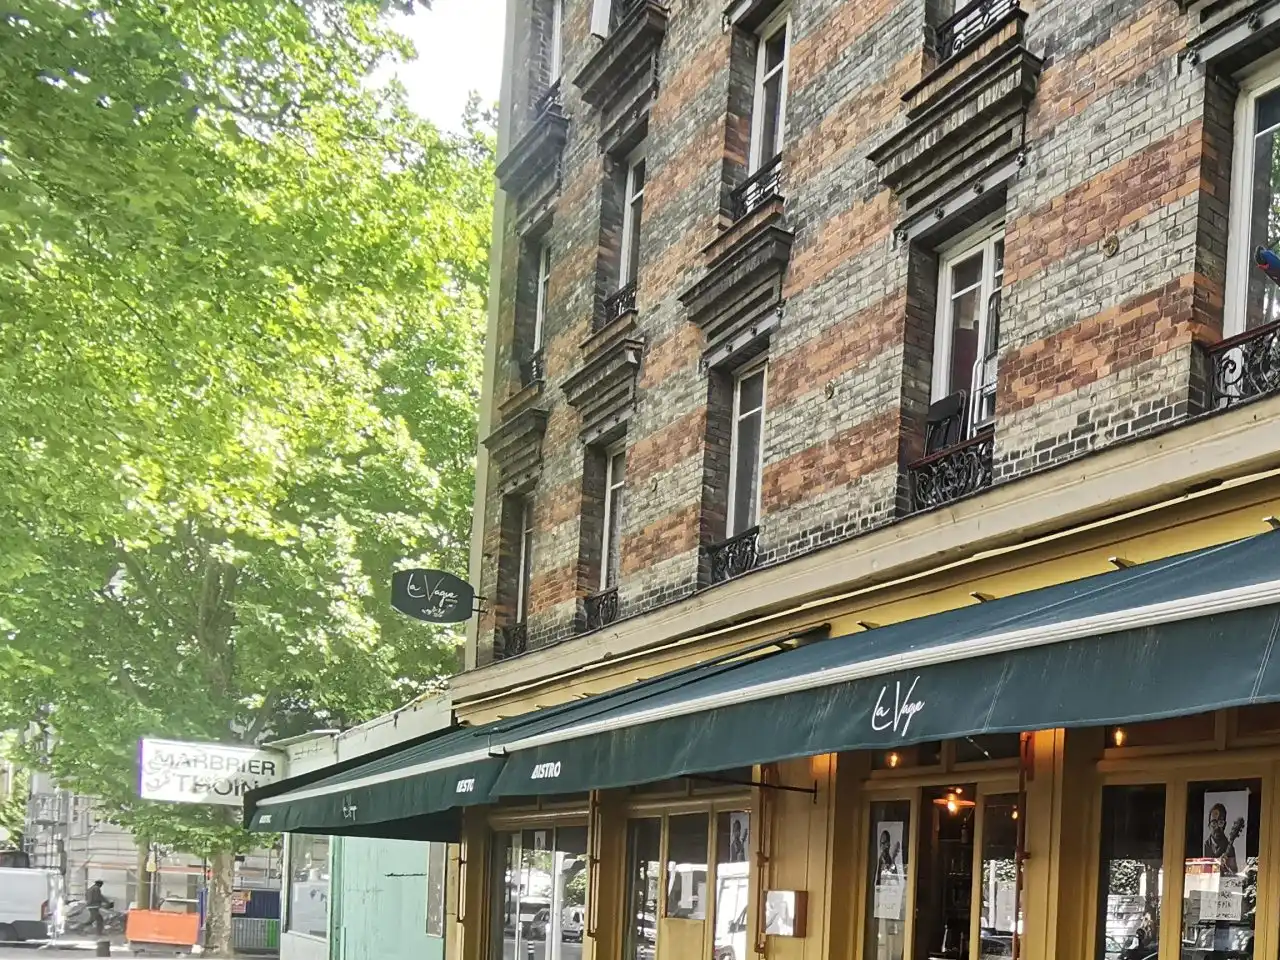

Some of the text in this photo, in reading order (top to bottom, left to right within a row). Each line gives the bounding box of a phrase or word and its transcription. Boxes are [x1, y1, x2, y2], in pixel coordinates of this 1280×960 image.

[407, 573, 458, 608] La Vague
[871, 675, 926, 737] La Vague
[156, 752, 276, 776] MARBRIER
[531, 761, 561, 779] BISTRO
